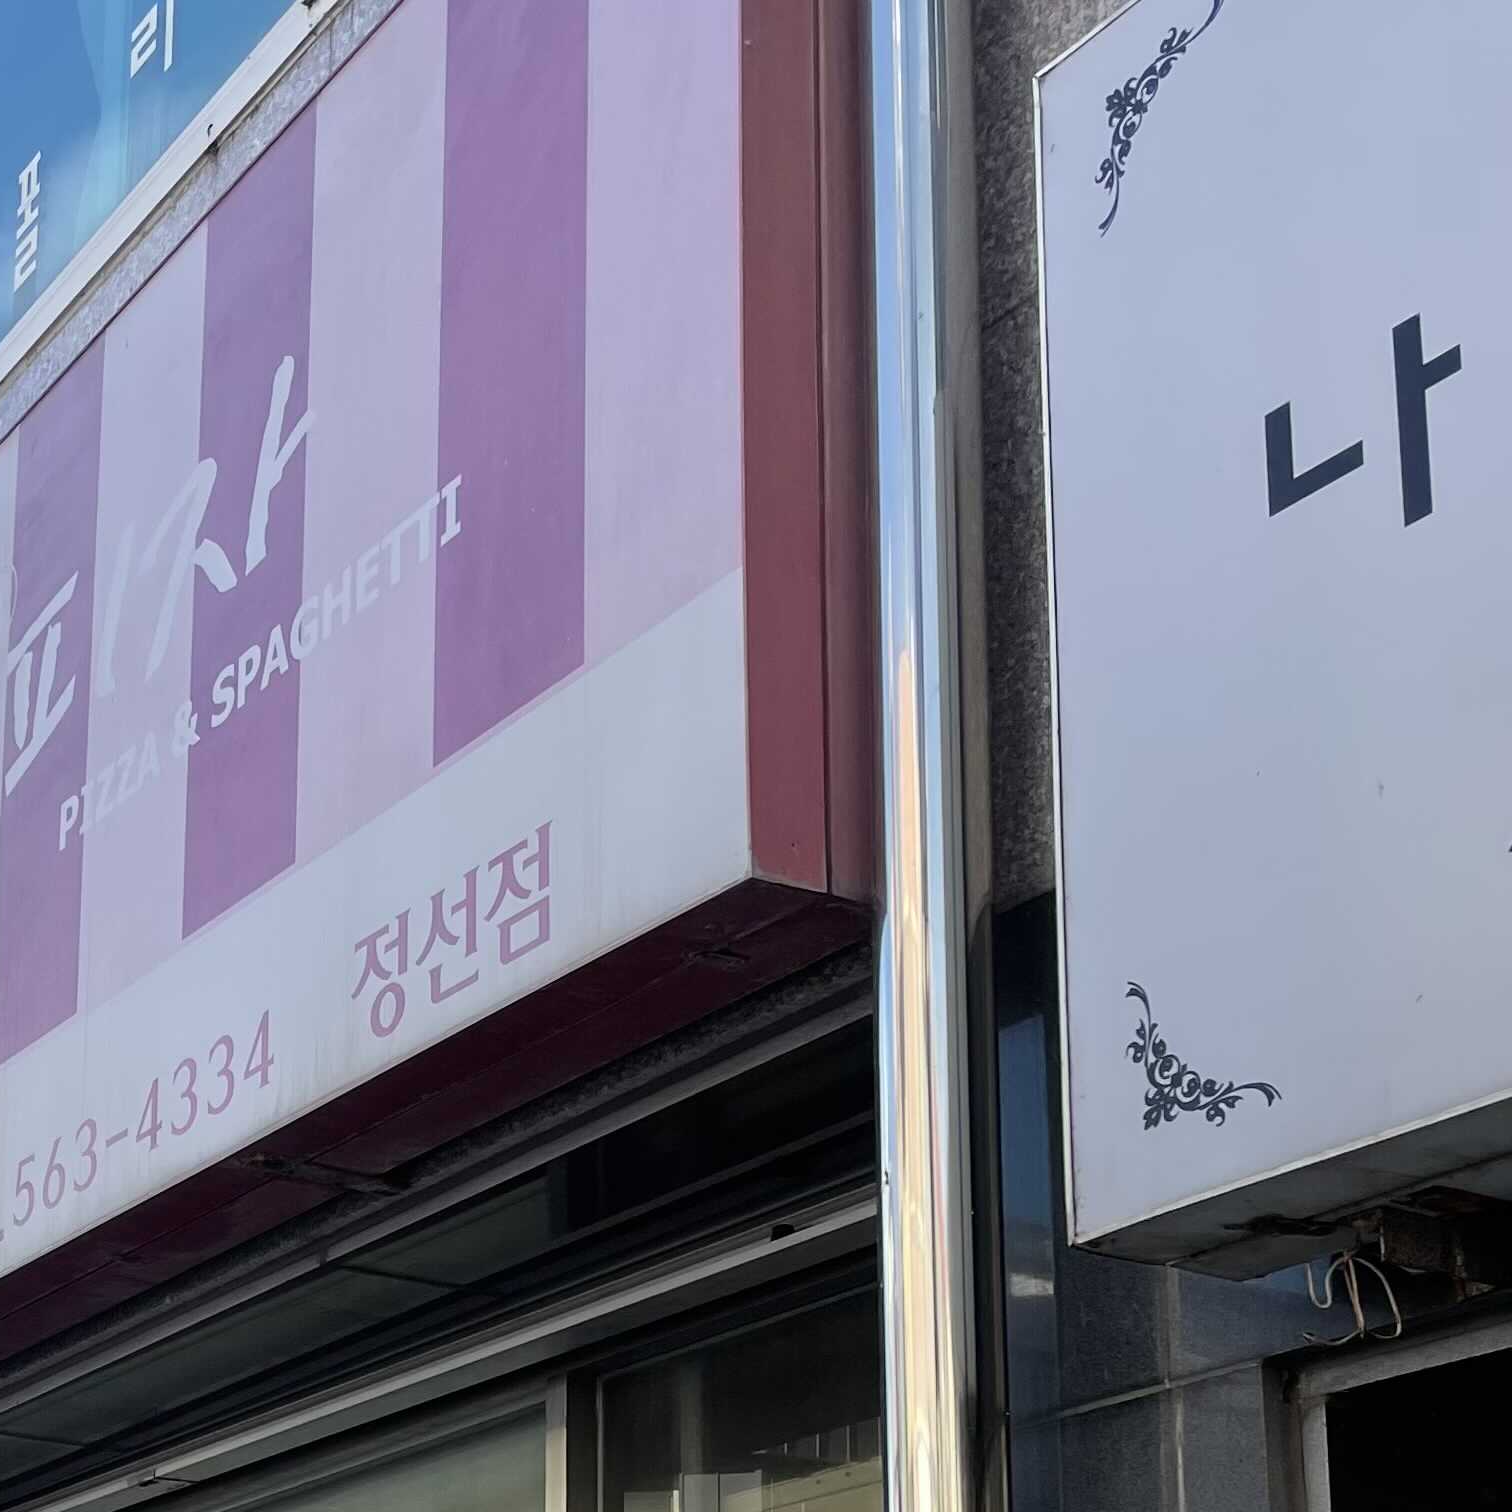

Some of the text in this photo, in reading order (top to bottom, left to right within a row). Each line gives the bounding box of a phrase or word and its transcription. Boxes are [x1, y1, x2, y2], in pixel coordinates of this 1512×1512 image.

[1265, 313, 1461, 527] 나
[59, 731, 161, 850] PIZZA
[211, 474, 462, 728] SPAGHETTI
[351, 820, 554, 1039] 정선점
